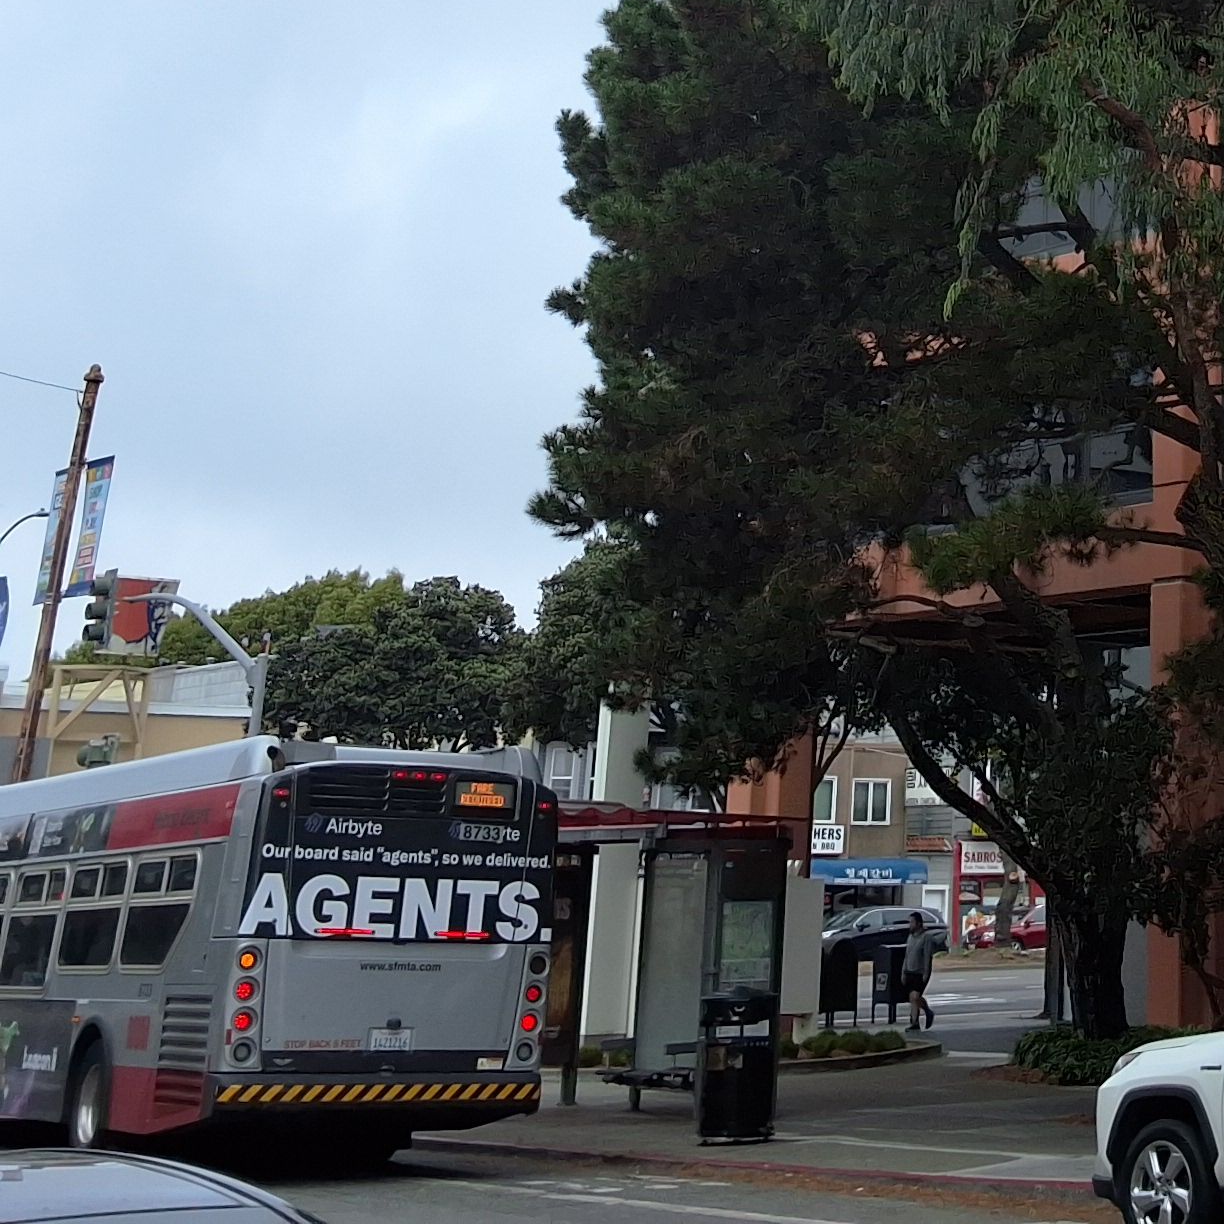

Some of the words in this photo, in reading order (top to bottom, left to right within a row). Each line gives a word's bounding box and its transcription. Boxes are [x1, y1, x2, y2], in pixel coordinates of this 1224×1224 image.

[471, 782, 495, 793] FARE
[325, 817, 383, 838] Airbyte
[463, 825, 501, 841] 8733
[262, 843, 291, 858] Our
[294, 844, 339, 860] board
[342, 846, 374, 862] said
[442, 852, 459, 865] so
[462, 853, 483, 866] we
[486, 853, 551, 868] delivered.
[238, 872, 553, 942] AGENTS.
[360, 961, 442, 972] www.sfmta.com
[283, 1039, 307, 1049] STOP
[309, 1039, 331, 1048] BACK
[340, 1038, 362, 1048] FEET
